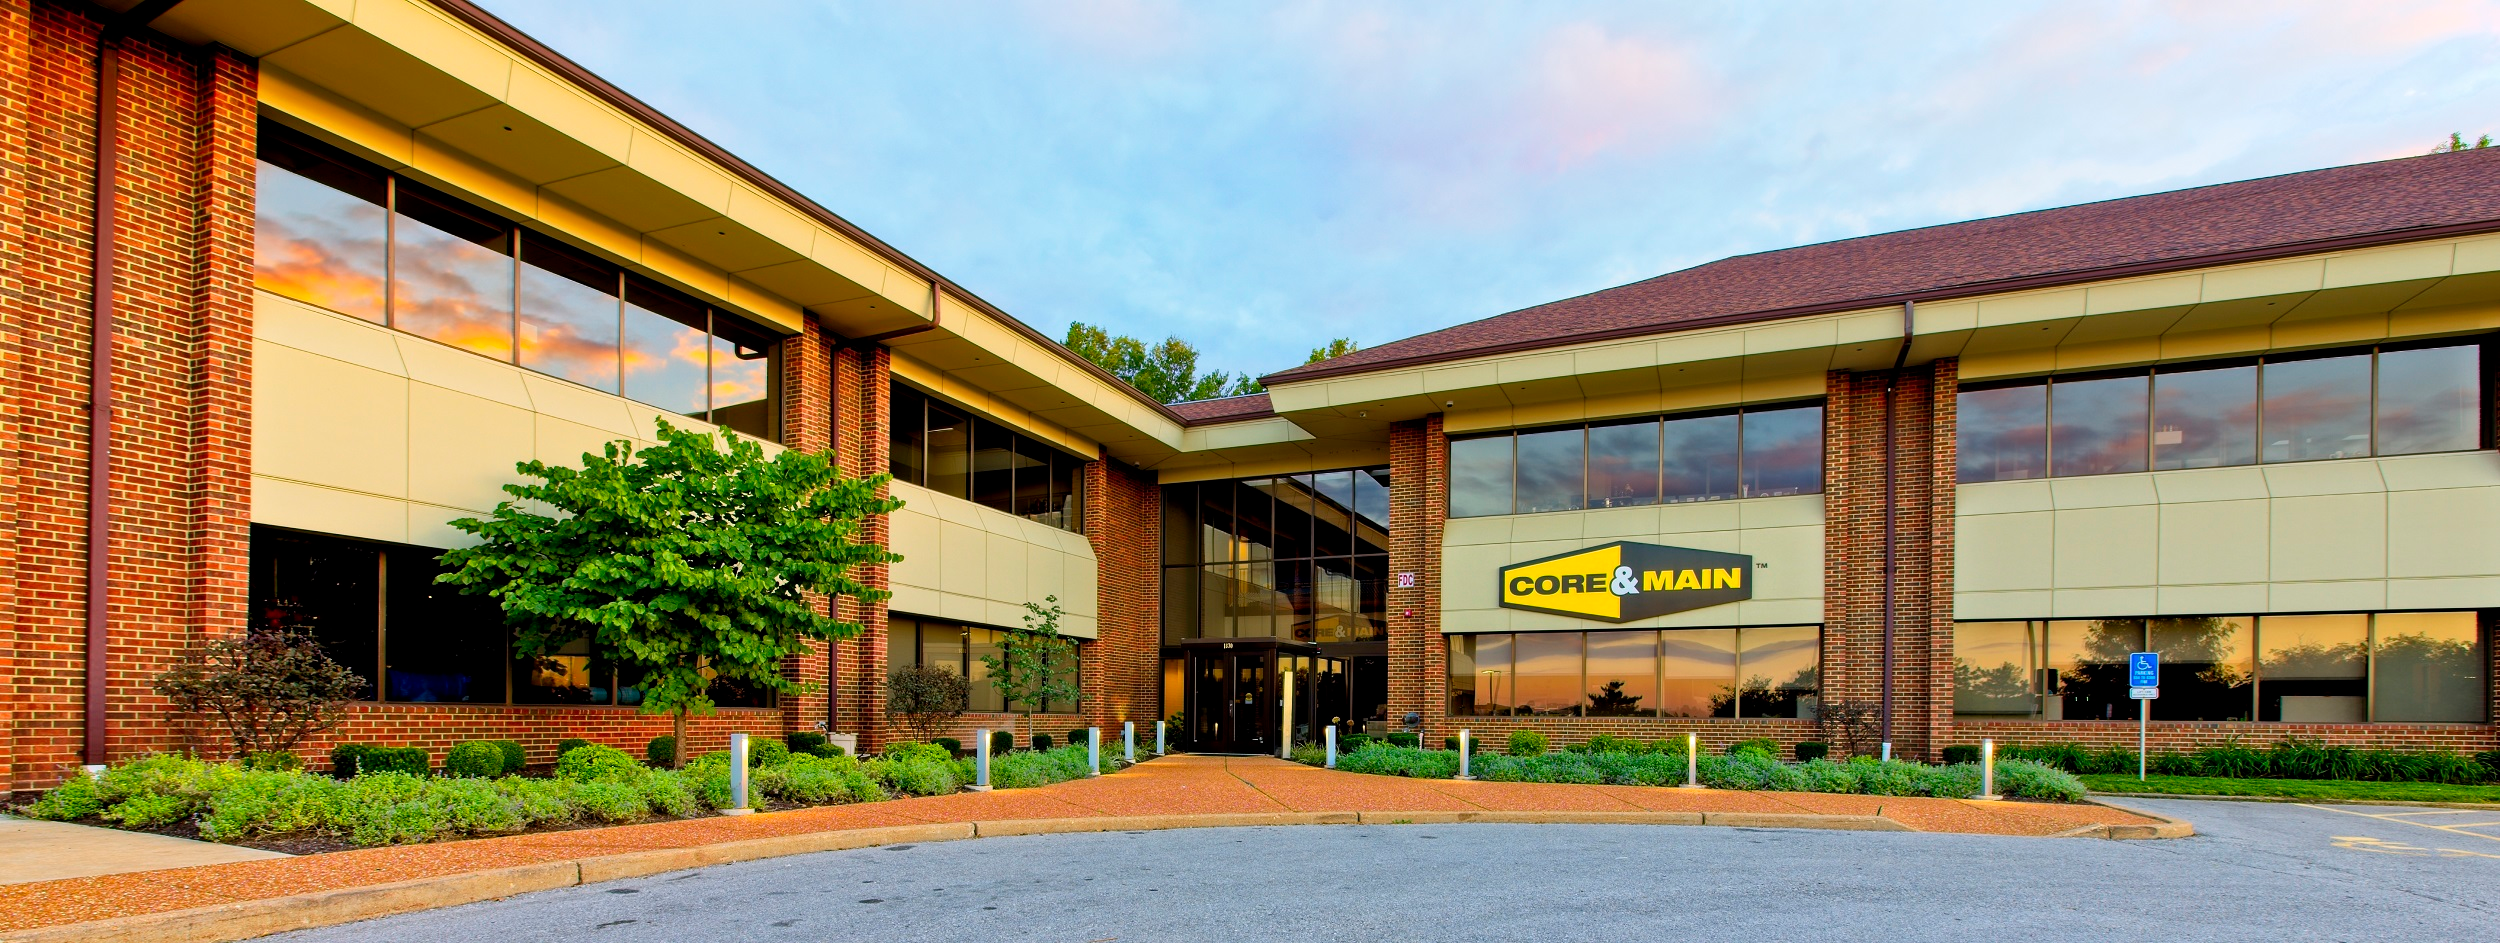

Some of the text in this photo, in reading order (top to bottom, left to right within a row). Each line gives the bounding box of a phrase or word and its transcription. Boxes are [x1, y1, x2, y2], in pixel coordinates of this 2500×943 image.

[1398, 574, 1413, 586] FDC
[1508, 564, 1742, 597] CORE & MAIN
